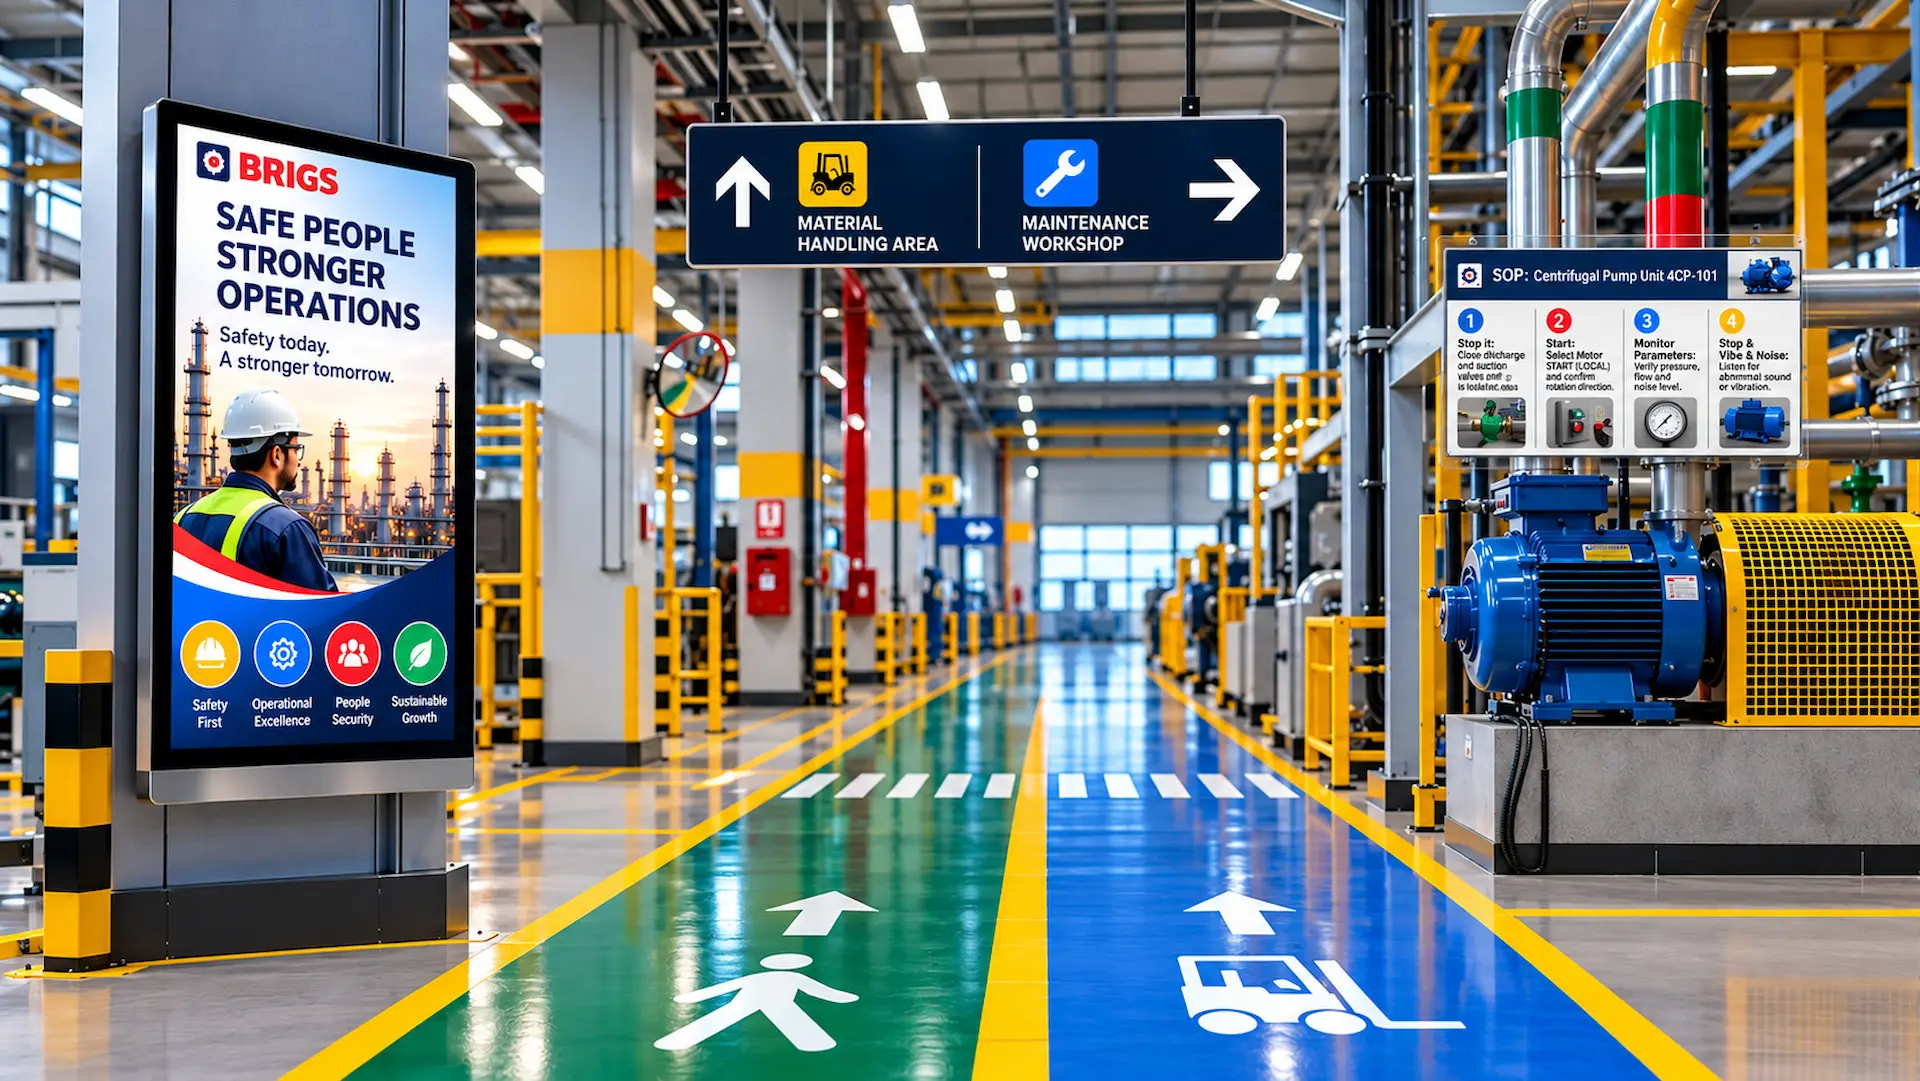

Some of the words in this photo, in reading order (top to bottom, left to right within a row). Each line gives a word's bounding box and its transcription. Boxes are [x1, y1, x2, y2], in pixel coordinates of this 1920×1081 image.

[239, 152, 338, 195] BRIGS
[216, 201, 295, 239] SAFE
[304, 214, 415, 258] PEOPLE
[798, 215, 883, 232] MATERIAL
[1022, 215, 1149, 231] MAINTENANCE
[798, 236, 888, 252] HANDLING
[893, 236, 938, 252] AREA
[1022, 236, 1124, 252] WORKSHOP
[216, 240, 385, 290] STRONGER
[1492, 268, 1528, 283] SOP:
[1533, 269, 1600, 284] Centrifugal
[1603, 269, 1637, 285] Pump
[1640, 269, 1664, 283] Unit
[1666, 269, 1718, 282] 4CP-101
[216, 279, 421, 331] OPERATIONS
[1553, 314, 1564, 328] 2
[1642, 314, 1652, 328] 3
[1726, 313, 1737, 328] 4
[220, 326, 274, 351] Safety
[279, 331, 330, 358] today.
[1457, 338, 1482, 350] Stop
[1484, 338, 1495, 348] it:
[1546, 338, 1575, 348] Start:
[1634, 338, 1675, 348] Monitor
[1719, 338, 1743, 350] Stop
[1746, 338, 1754, 348] &
[1634, 350, 1696, 360] Parameters:
[1719, 350, 1743, 360] Vibe
[1745, 350, 1753, 360] &
[1756, 350, 1789, 360] Noise:
[219, 351, 232, 367] A
[237, 353, 309, 378] stronger
[314, 360, 394, 384] tomorrow.
[1546, 361, 1574, 370] START
[1575, 361, 1611, 372] (LOCAL)
[1546, 372, 1562, 381] and
[1763, 372, 1792, 381] sound
[1634, 382, 1658, 391] noise
[1659, 382, 1682, 391] level.
[192, 697, 229, 713] Safety
[252, 697, 313, 712] Operational
[335, 696, 371, 711] People
[391, 695, 448, 708] Sustainable
[197, 716, 223, 729] First
[254, 715, 311, 727] Excellence
[332, 713, 374, 728] Security
[402, 711, 438, 724] Growth
